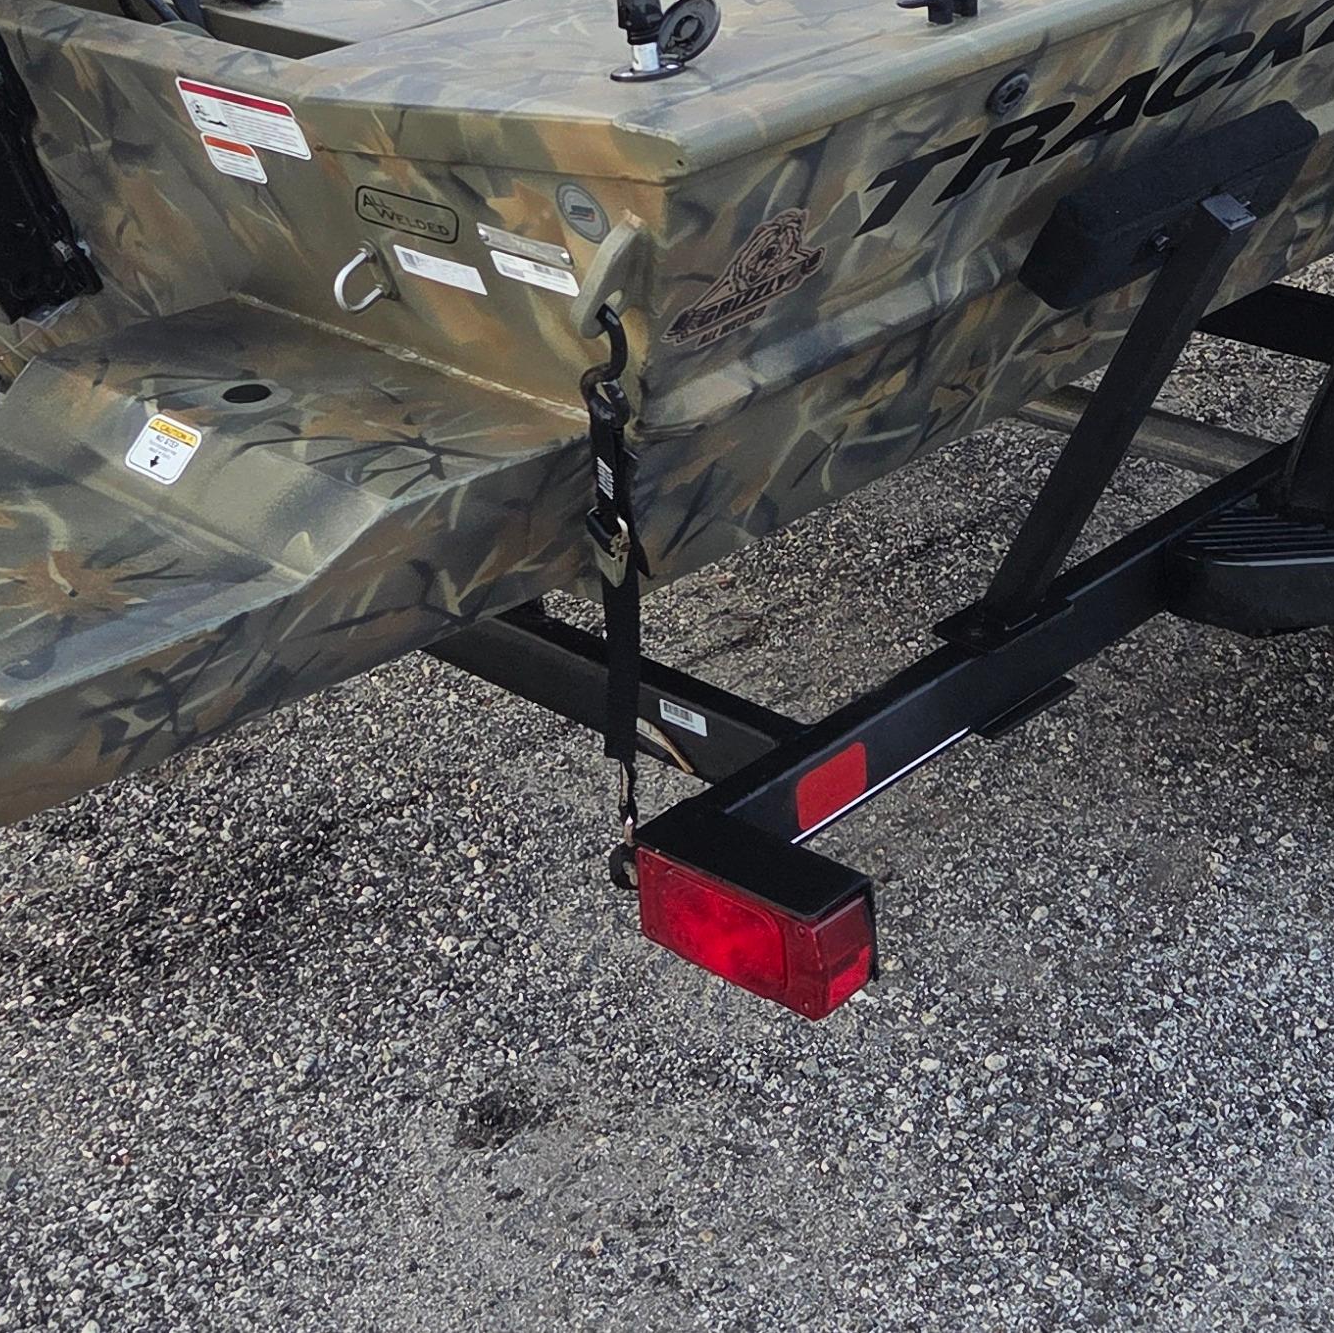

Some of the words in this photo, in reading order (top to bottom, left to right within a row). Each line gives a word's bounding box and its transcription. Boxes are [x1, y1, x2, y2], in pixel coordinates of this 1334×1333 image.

[362, 193, 393, 211] ALL
[378, 207, 451, 237] WELDED
[693, 268, 794, 328] GRIZZLY
